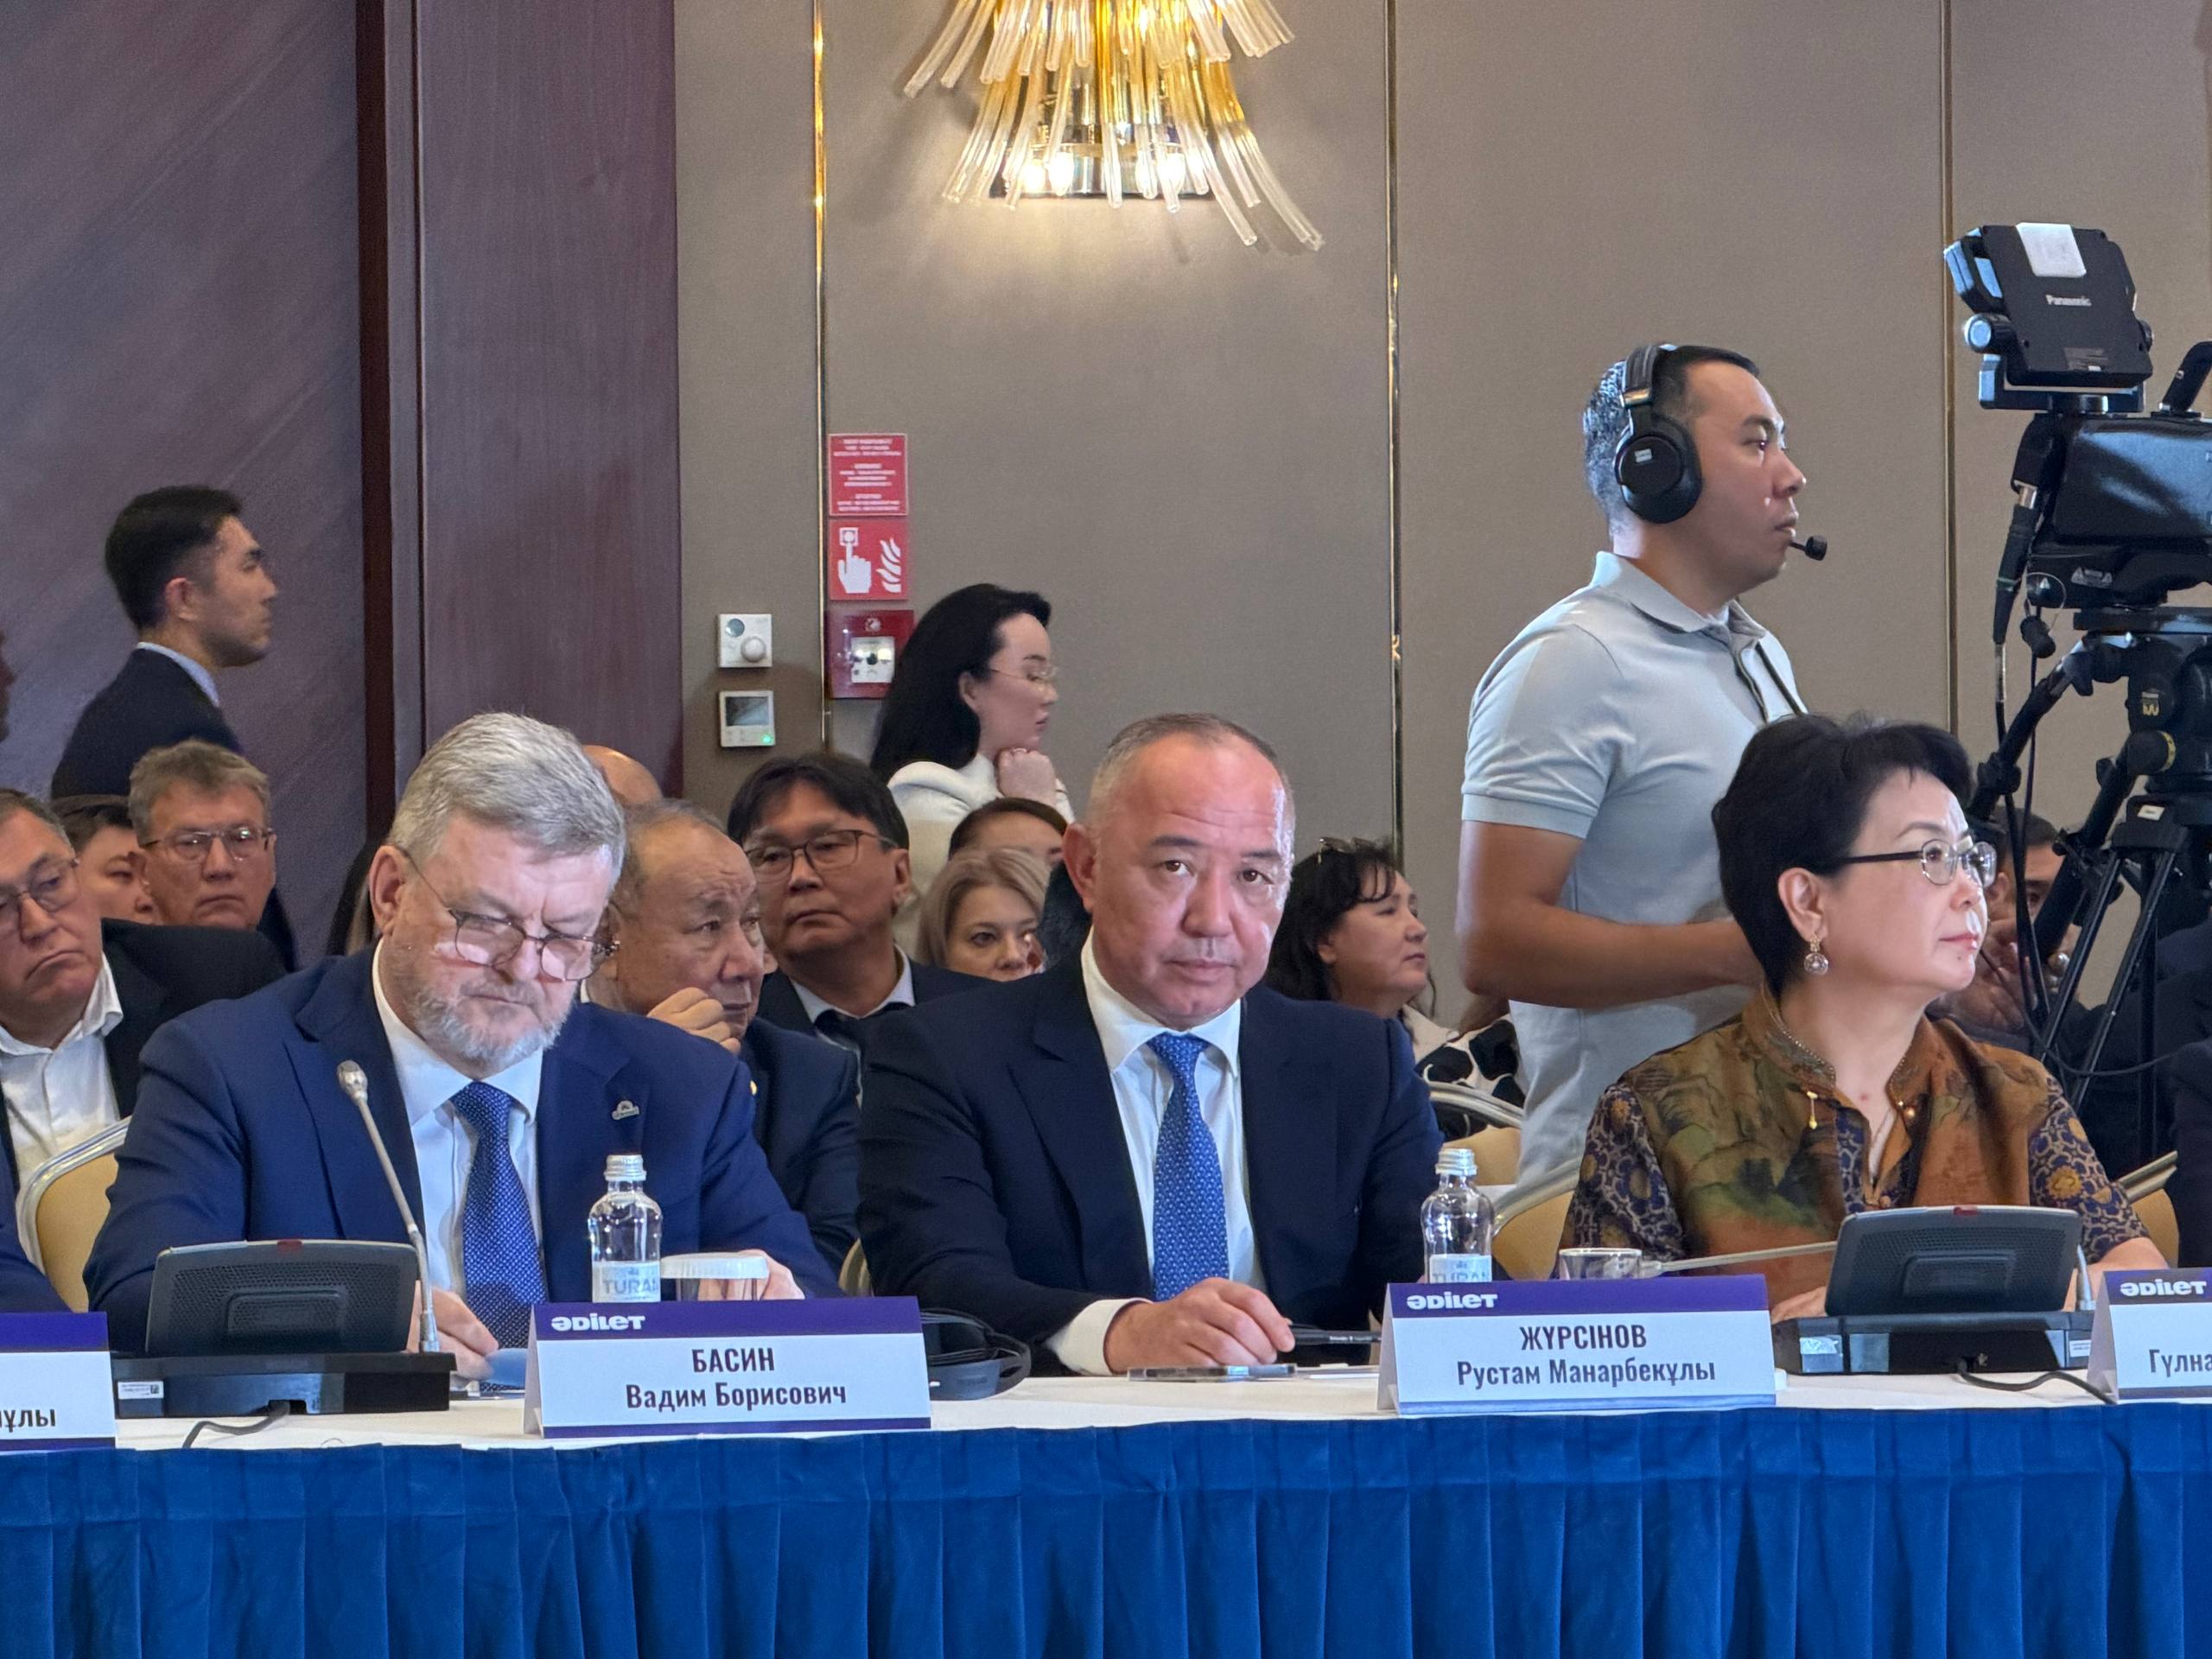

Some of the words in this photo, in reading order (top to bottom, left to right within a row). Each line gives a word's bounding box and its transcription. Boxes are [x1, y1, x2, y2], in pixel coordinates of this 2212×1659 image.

[1519, 1324, 1647, 1351] ЖҮРСІНОВ
[691, 1347, 775, 1373] БАСИН
[1457, 1361, 1541, 1390] Рустам
[1549, 1357, 1715, 1388] Манарбекұлы
[626, 1384, 707, 1413] Вадим
[715, 1382, 847, 1411] Борисович
[0, 1408, 56, 1433] ұлы
